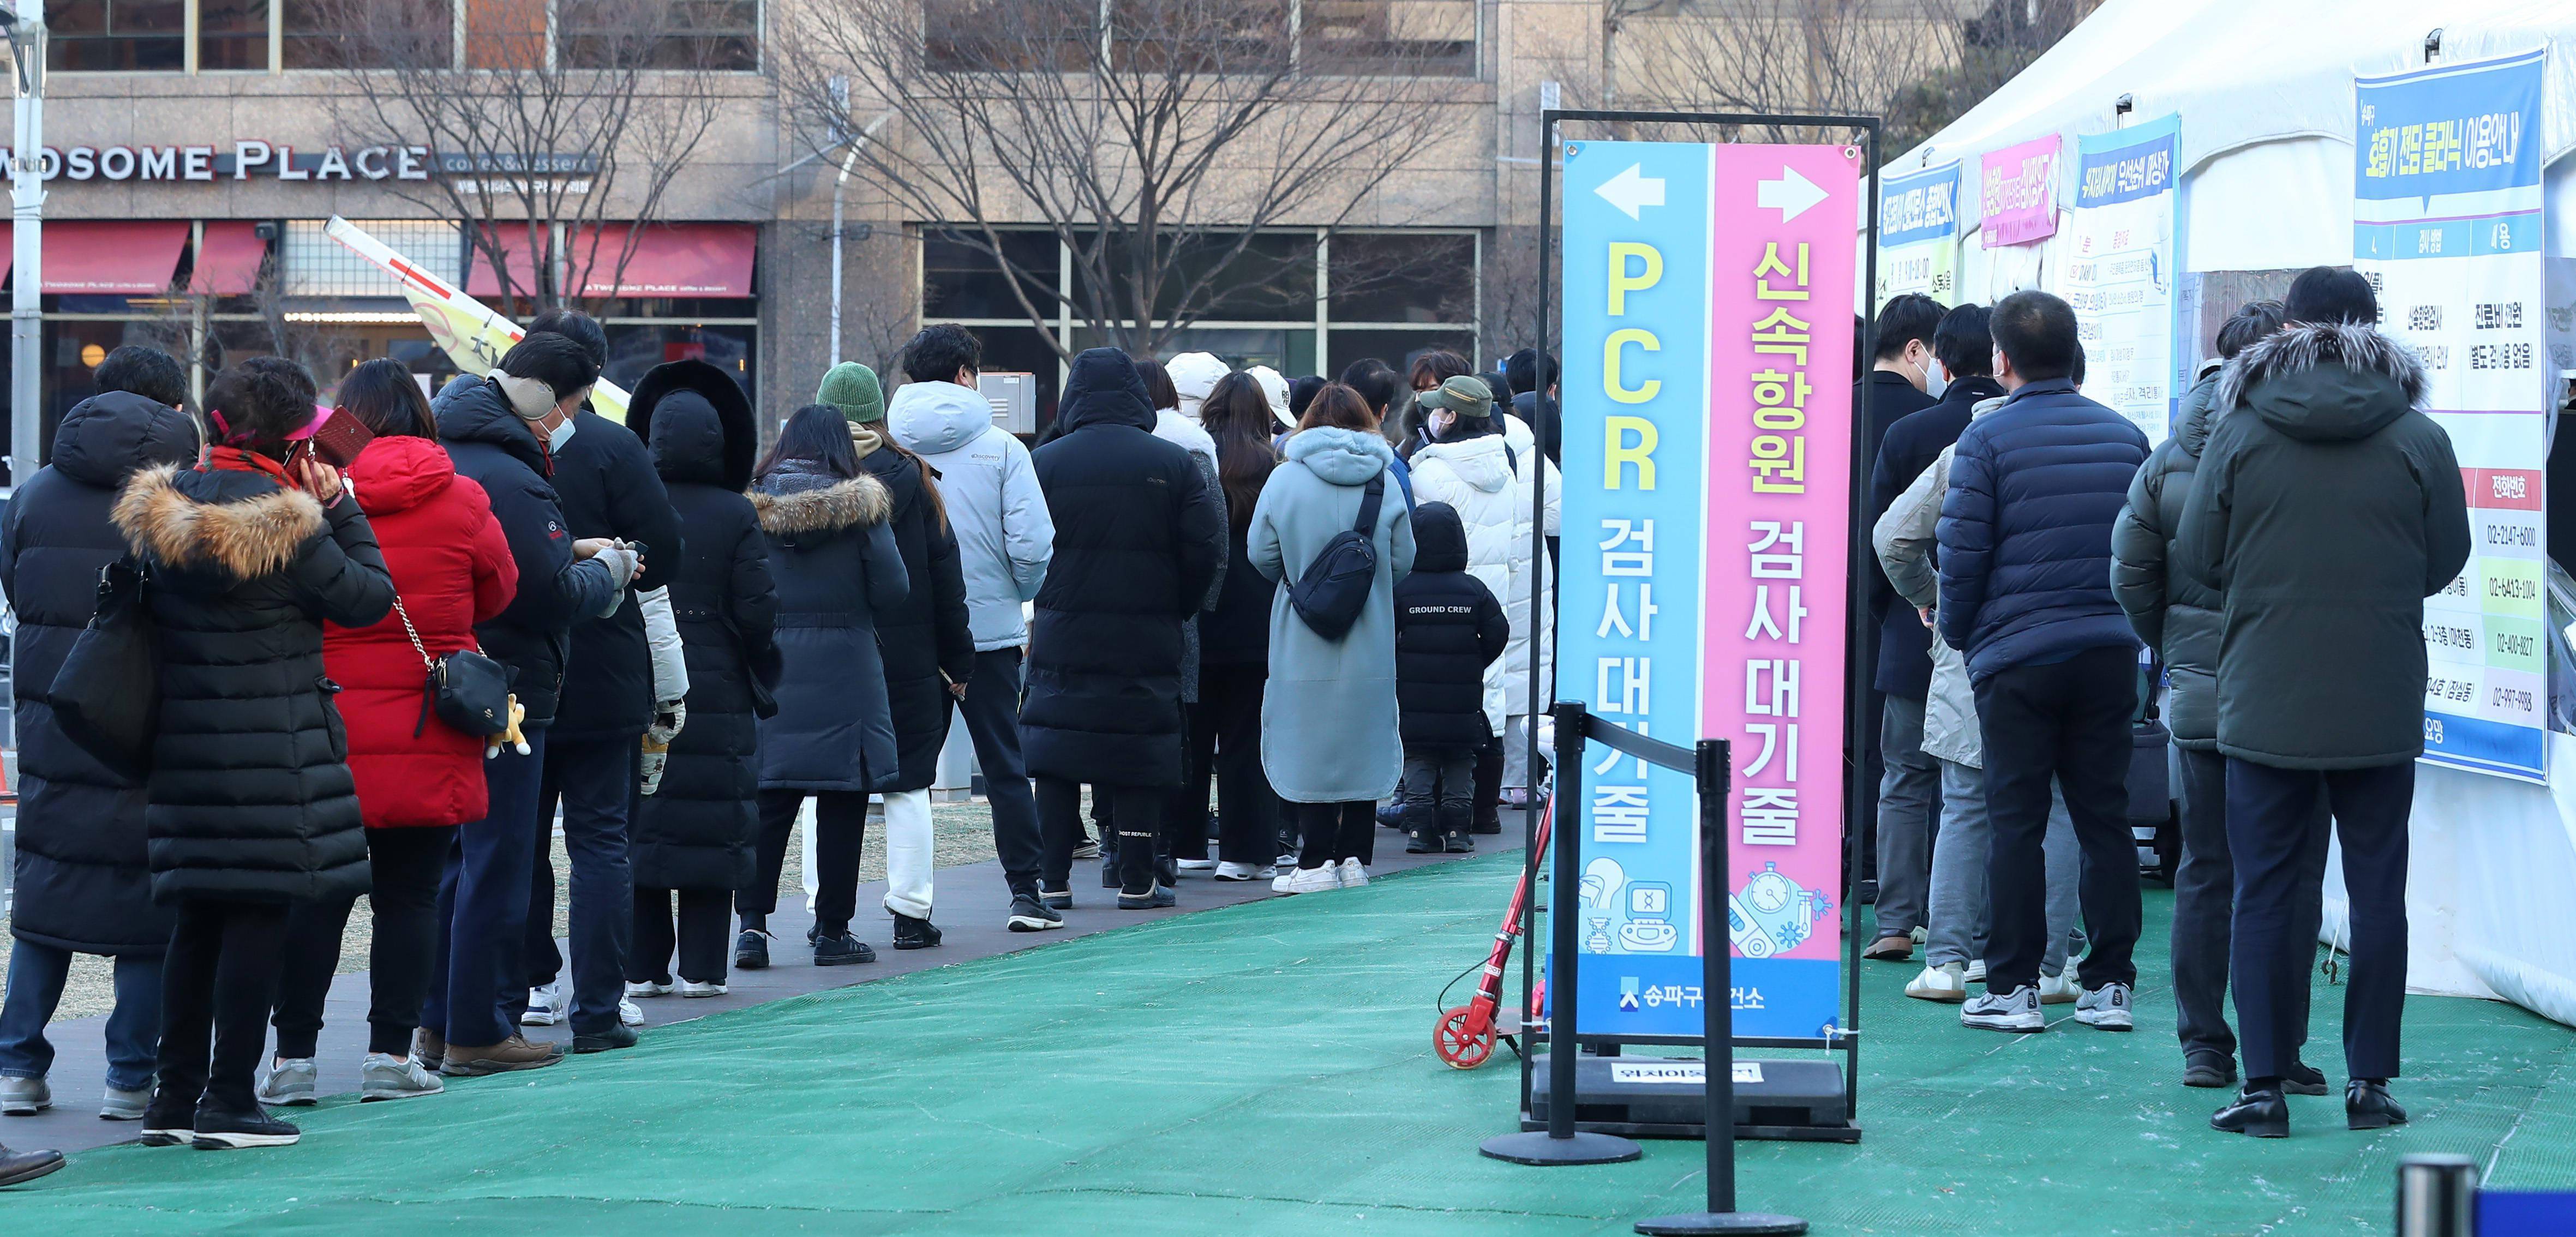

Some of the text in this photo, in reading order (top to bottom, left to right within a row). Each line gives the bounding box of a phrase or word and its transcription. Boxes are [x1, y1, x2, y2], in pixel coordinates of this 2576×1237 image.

[2366, 111, 2519, 178] 호흡기 전담 클리닉 이용안내
[235, 139, 428, 181] PLACE
[2118, 156, 2146, 194] 우선순위
[2408, 305, 2442, 331] 신속항원검사
[2476, 303, 2503, 329] 진료비
[1603, 242, 1663, 490] PCR
[2491, 475, 2526, 499] 전화번호
[1741, 242, 1812, 845] 신속항원 검사 대기줄
[2487, 525, 2536, 547] 02-2147-6000
[1596, 519, 1658, 641] 검사
[2489, 577, 2536, 600] 02-6413-1004
[2448, 626, 2475, 650] (마천동)
[2497, 633, 2533, 657] 02-400-8827
[2444, 680, 2475, 702] (잠실동)
[2493, 687, 2532, 712] 02-997-9988
[2424, 717, 2444, 744] 요망
[1643, 984, 1765, 1010] 송파구건소
